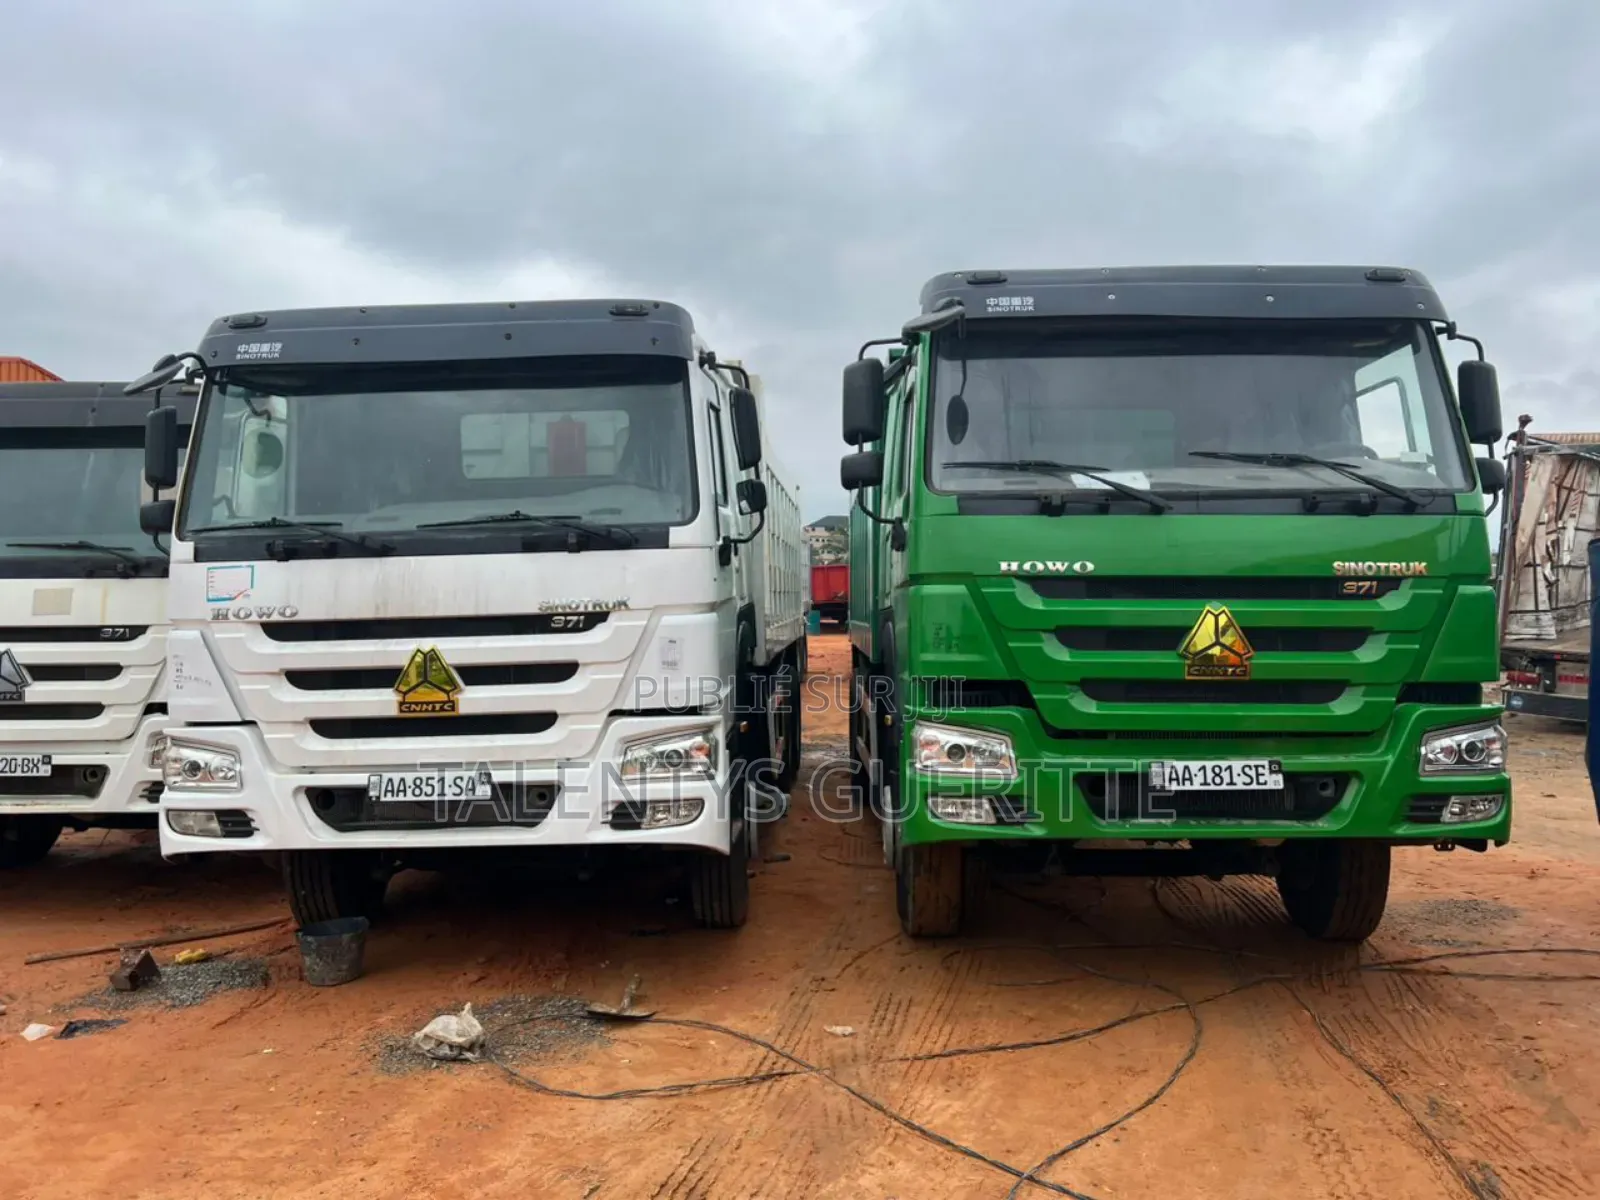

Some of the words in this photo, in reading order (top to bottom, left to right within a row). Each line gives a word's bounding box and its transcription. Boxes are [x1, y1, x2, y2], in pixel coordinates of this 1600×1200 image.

[998, 560, 1095, 574] HOWO
[1332, 560, 1427, 577] SINOTRUK
[1343, 581, 1377, 595] 371
[538, 597, 630, 612] SINOTRUK
[210, 604, 299, 621] HOWO
[551, 615, 585, 629] 371
[100, 628, 130, 638] 371
[400, 702, 453, 712] CNHTC
